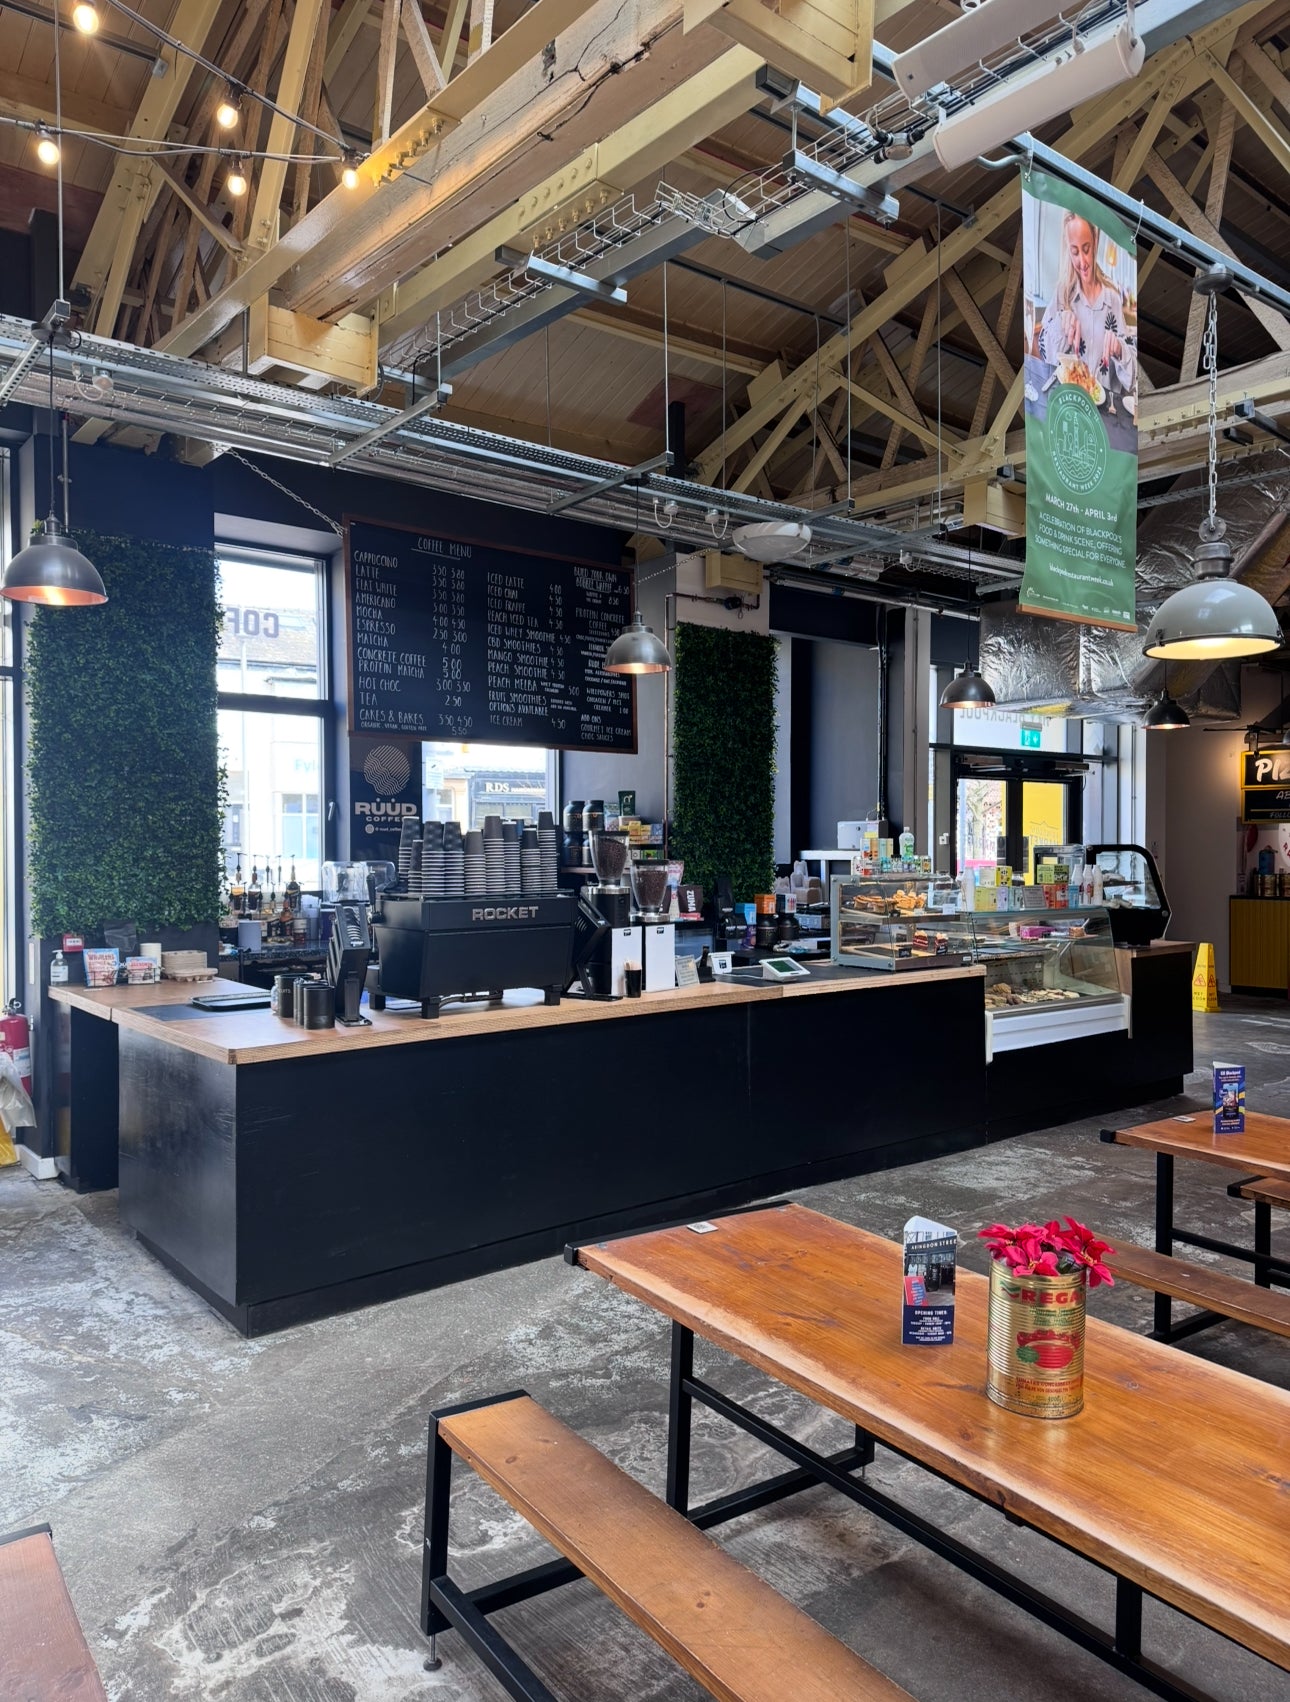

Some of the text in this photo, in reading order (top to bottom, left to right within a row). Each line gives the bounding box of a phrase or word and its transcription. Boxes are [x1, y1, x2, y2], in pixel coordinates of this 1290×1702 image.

[1059, 393, 1093, 417] BLACKPOOL
[1080, 481, 1093, 491] WEEK
[1046, 493, 1118, 522] MARCH 27th APRIL 3rd
[1043, 513, 1075, 532] CELEBRATION
[1077, 525, 1085, 534] OF
[1086, 528, 1122, 543] BLACKPOOL'S
[1035, 534, 1063, 552] SOMETHING
[1063, 545, 1085, 558] SPECIAL
[1086, 551, 1099, 560] FOR
[1039, 523, 1053, 536] FOOD
[1058, 532, 1073, 543] DRINK
[1074, 536, 1096, 549] SCENE,
[1097, 541, 1122, 555] OFFERING
[418, 538, 472, 558] COFFEE MENU
[354, 550, 398, 568] CAPPUCCINO
[356, 564, 380, 579] LATTE
[356, 578, 372, 592] FLAT
[375, 582, 397, 597] WHITE
[488, 572, 503, 585] ICED
[506, 576, 524, 589] LATTE
[356, 592, 396, 608] AMERICANO
[488, 585, 502, 597] ICED
[505, 588, 518, 600] CHAI
[356, 606, 383, 620] MOCHA
[488, 597, 502, 609] ICED
[505, 600, 525, 613] FRAPPE
[488, 610, 507, 623] PEACH
[510, 613, 524, 625] ICED
[527, 616, 539, 628] TEA
[576, 607, 625, 624] PROTEIN CONCRETE
[357, 619, 396, 635] ESPRESSO
[488, 624, 555, 643] ICED WHEY SMOOTHIE
[589, 620, 607, 631] COFFEE
[357, 632, 388, 647] MATCHA
[488, 636, 501, 648] CBD
[504, 639, 541, 654] SMOOTHIES
[358, 647, 397, 664] CONCRETE
[400, 652, 427, 667] COFFEE
[488, 650, 512, 662] MANGO
[517, 653, 548, 668] SMOOTHIE
[359, 660, 391, 674] PROTEIN
[398, 665, 424, 679] MATCHA
[488, 662, 509, 674] PEACH
[514, 665, 548, 680] SMOOTHIE
[359, 676, 376, 690] HOT
[380, 679, 401, 692] CHOC
[488, 675, 510, 688] PEACH
[515, 679, 537, 691] MELBA
[360, 692, 378, 706] TEA
[489, 690, 506, 702] FRUIT
[510, 693, 546, 705] SMOOTHIES
[360, 709, 385, 722] CAKES
[389, 710, 395, 722] &
[398, 711, 424, 725] BAKES
[489, 702, 515, 713] OPTIONS
[518, 704, 548, 716] AVAILABLE
[490, 715, 500, 725] ICE
[502, 716, 522, 727] CREAM
[485, 782, 510, 793] RDS
[472, 906, 539, 920] ROCKET
